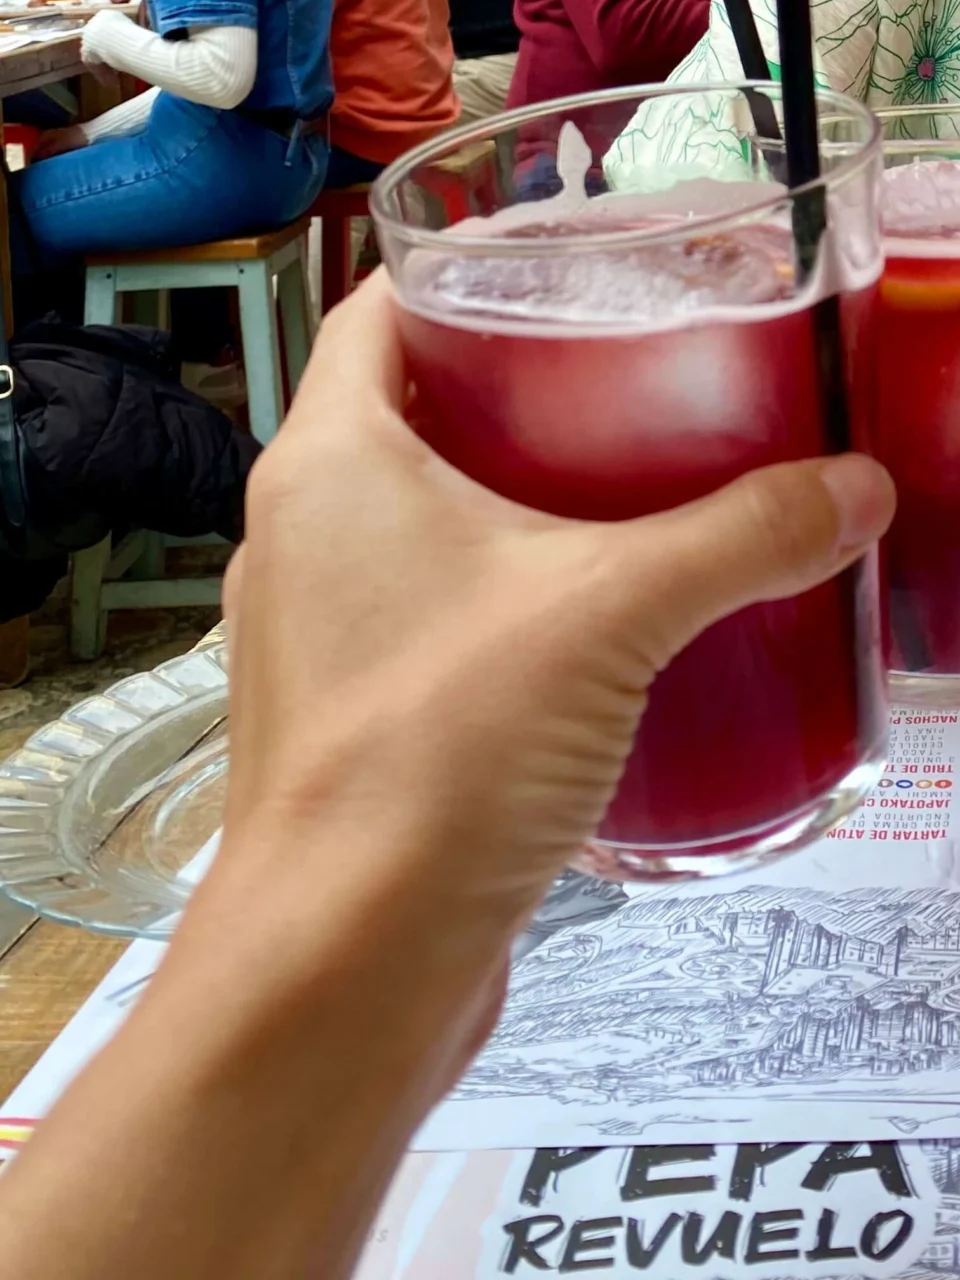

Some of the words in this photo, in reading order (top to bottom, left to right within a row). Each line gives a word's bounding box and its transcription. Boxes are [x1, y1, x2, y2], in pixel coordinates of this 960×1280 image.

[905, 716, 957, 724] NACHOS
[901, 764, 918, 773] DE
[923, 764, 953, 773] TRIO
[880, 799, 951, 808] JAPOTAKO
[874, 812, 950, 820] ENCURTIDA
[873, 821, 917, 829] CREMA
[924, 820, 949, 828] CON
[826, 828, 864, 840] ATÚN
[869, 830, 887, 840] DE
[893, 829, 947, 840] TARTAR
[499, 1208, 914, 1274] REVUELO
